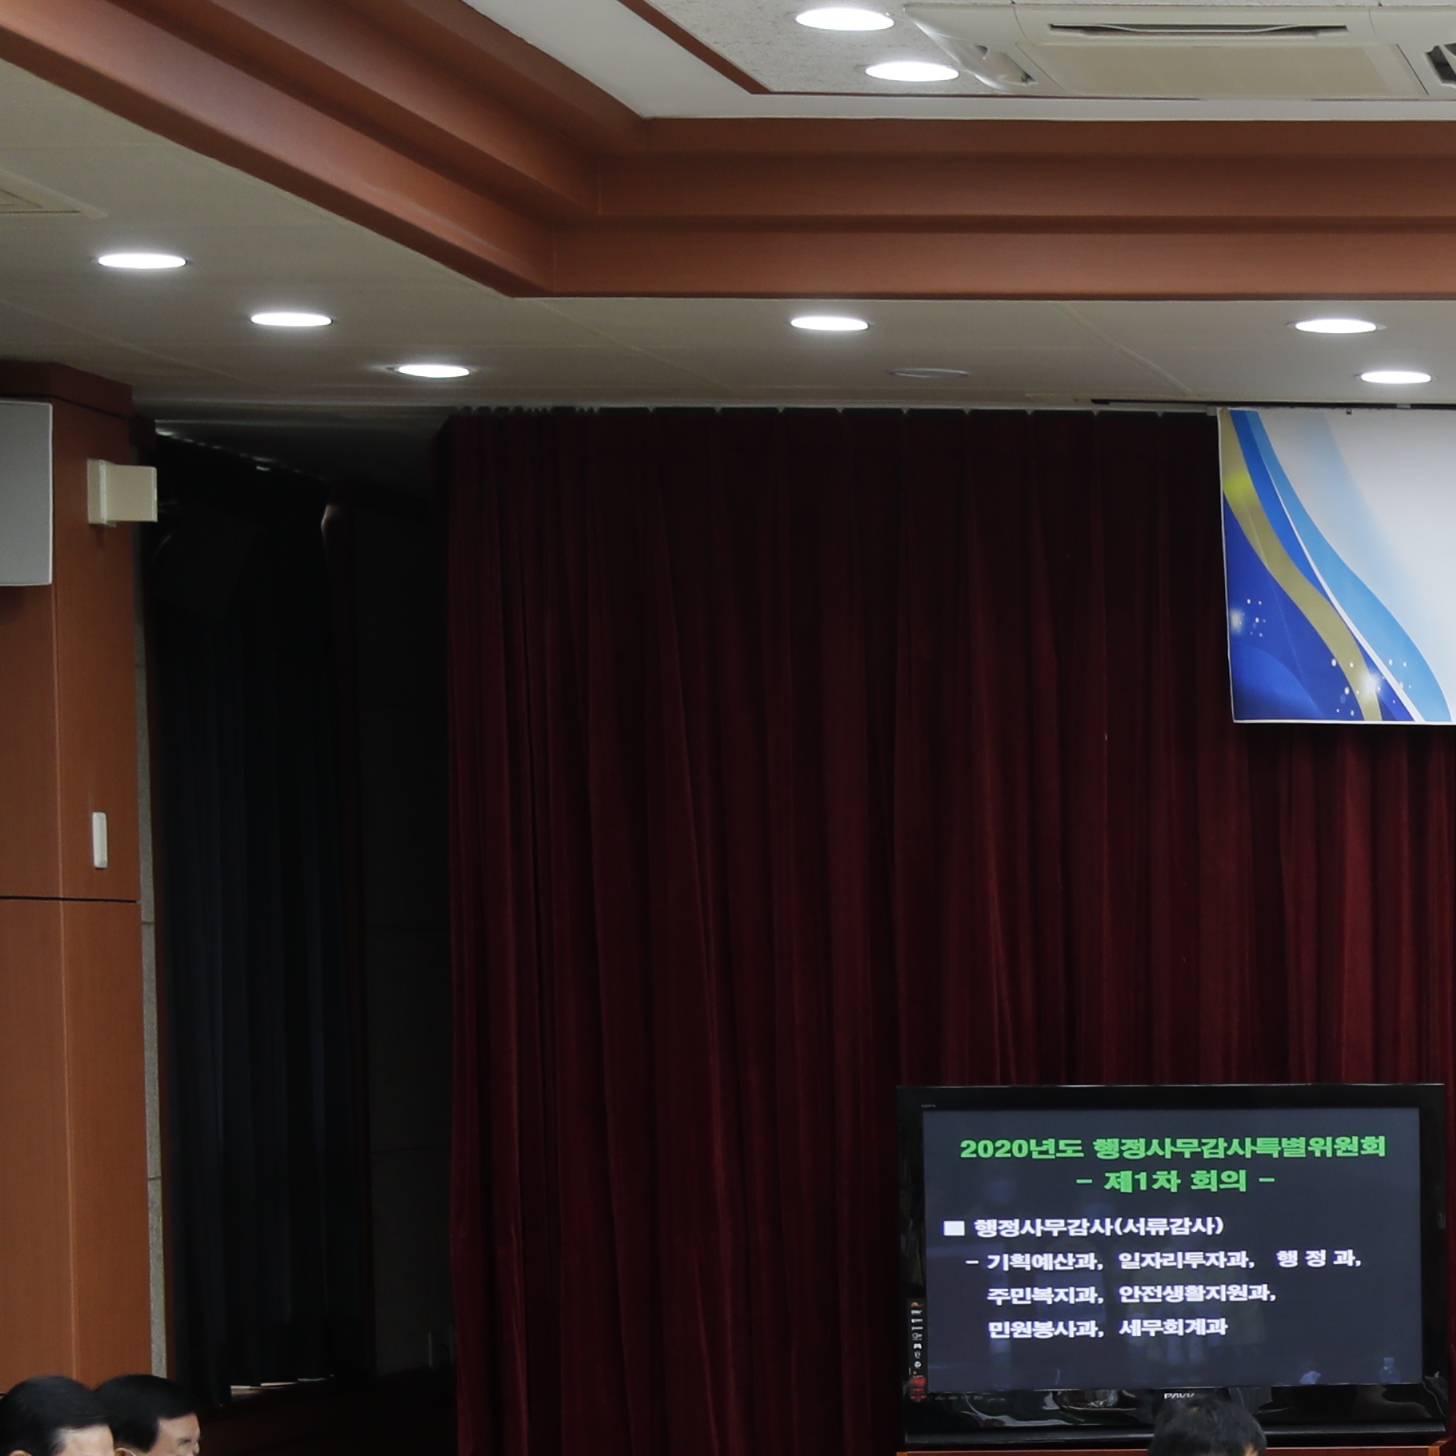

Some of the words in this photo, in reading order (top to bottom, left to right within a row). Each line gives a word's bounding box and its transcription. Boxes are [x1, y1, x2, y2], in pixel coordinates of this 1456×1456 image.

[960, 1138, 1085, 1160] 2020년도
[1093, 1135, 1386, 1160] 행정사무감사특별위원회
[1104, 1170, 1182, 1193] 제1차
[1191, 1169, 1247, 1192] 회의
[973, 1216, 1224, 1238] 행정사무감사(서류감사)
[987, 1252, 1104, 1272] 기획예산과,
[1118, 1250, 1255, 1270] 일자리투자과,
[986, 1286, 1104, 1306] 주민복지과,
[1118, 1283, 1276, 1303] 안전생활지원과,
[988, 1319, 1105, 1339] 민원봉사과,
[1118, 1317, 1229, 1337] 세무회계과
